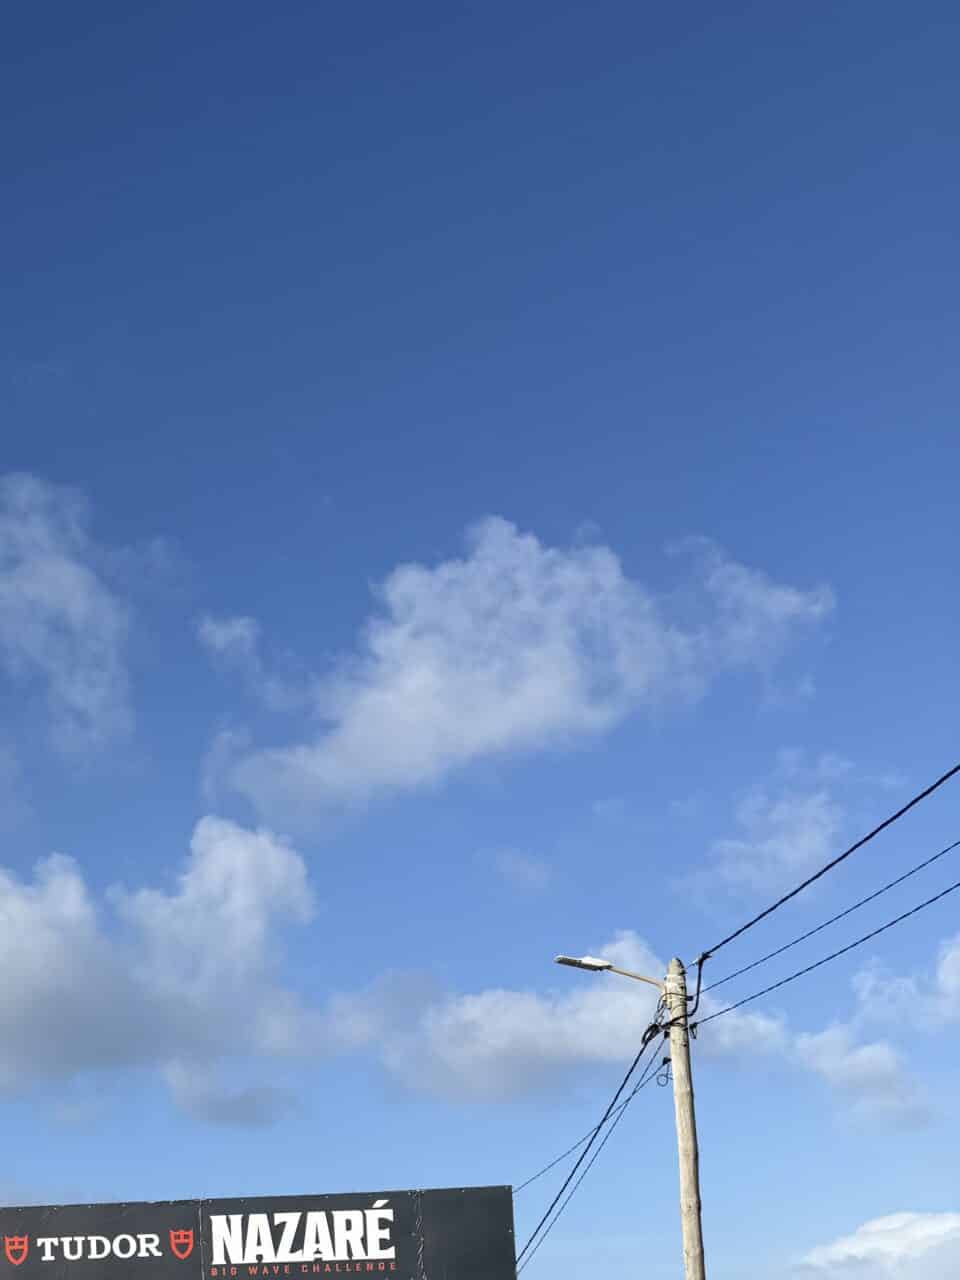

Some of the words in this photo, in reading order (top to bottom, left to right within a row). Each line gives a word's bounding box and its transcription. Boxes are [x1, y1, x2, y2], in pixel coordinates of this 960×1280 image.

[210, 1200, 396, 1265] NAZARÉ
[37, 1234, 162, 1261] TUDOR
[210, 1266, 238, 1277] BIG
[248, 1264, 291, 1276] WAVE
[300, 1262, 396, 1273] CHALLENGE
